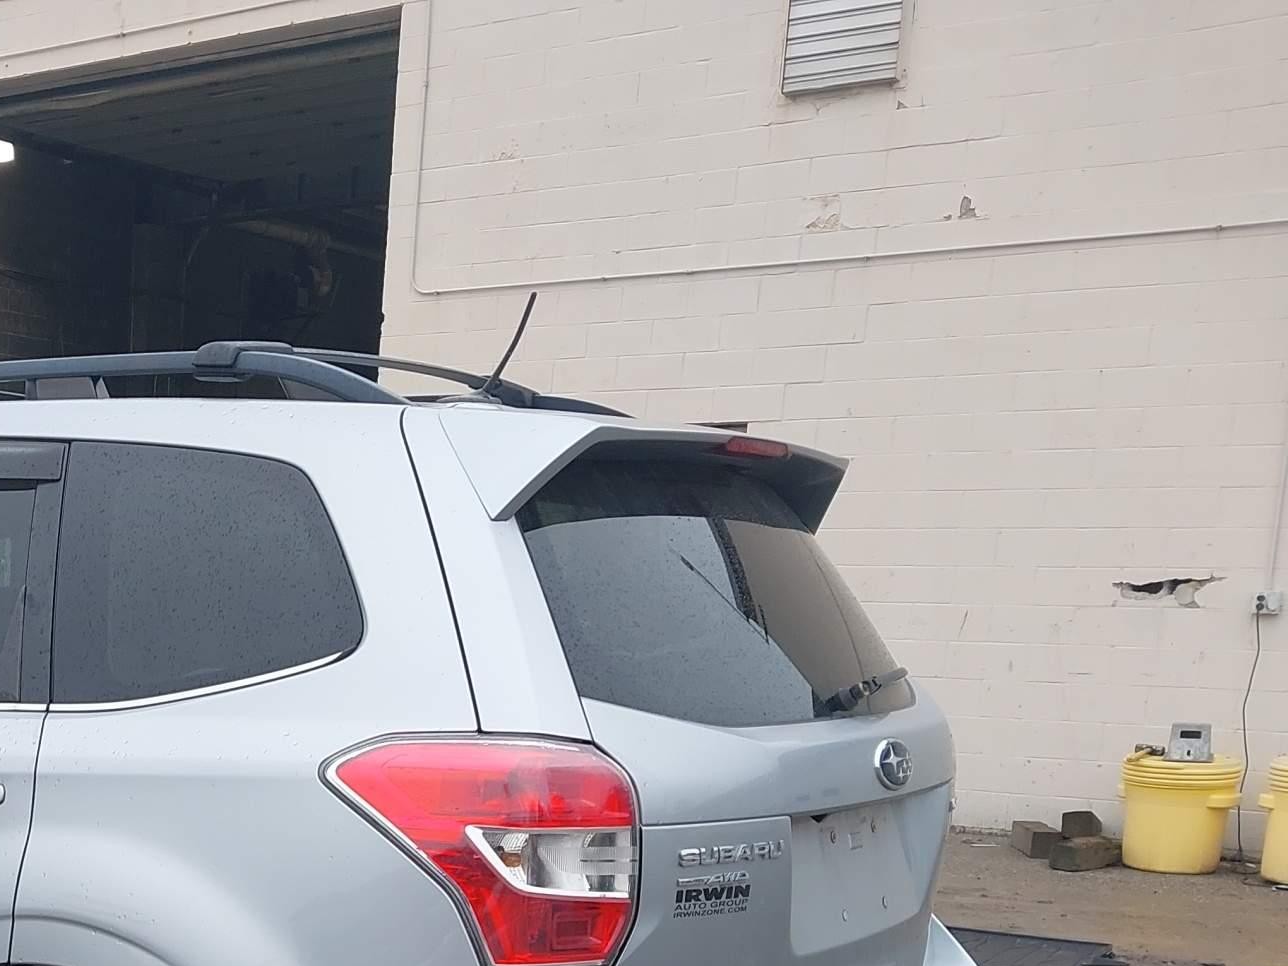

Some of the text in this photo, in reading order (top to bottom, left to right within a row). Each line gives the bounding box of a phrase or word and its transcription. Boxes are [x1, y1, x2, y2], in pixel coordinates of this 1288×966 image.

[678, 839, 785, 867] SUBARU
[675, 884, 751, 904] IRWIN
[673, 906, 748, 919] IRWINZONE.COM
[674, 898, 749, 912] AUTO GROUP
